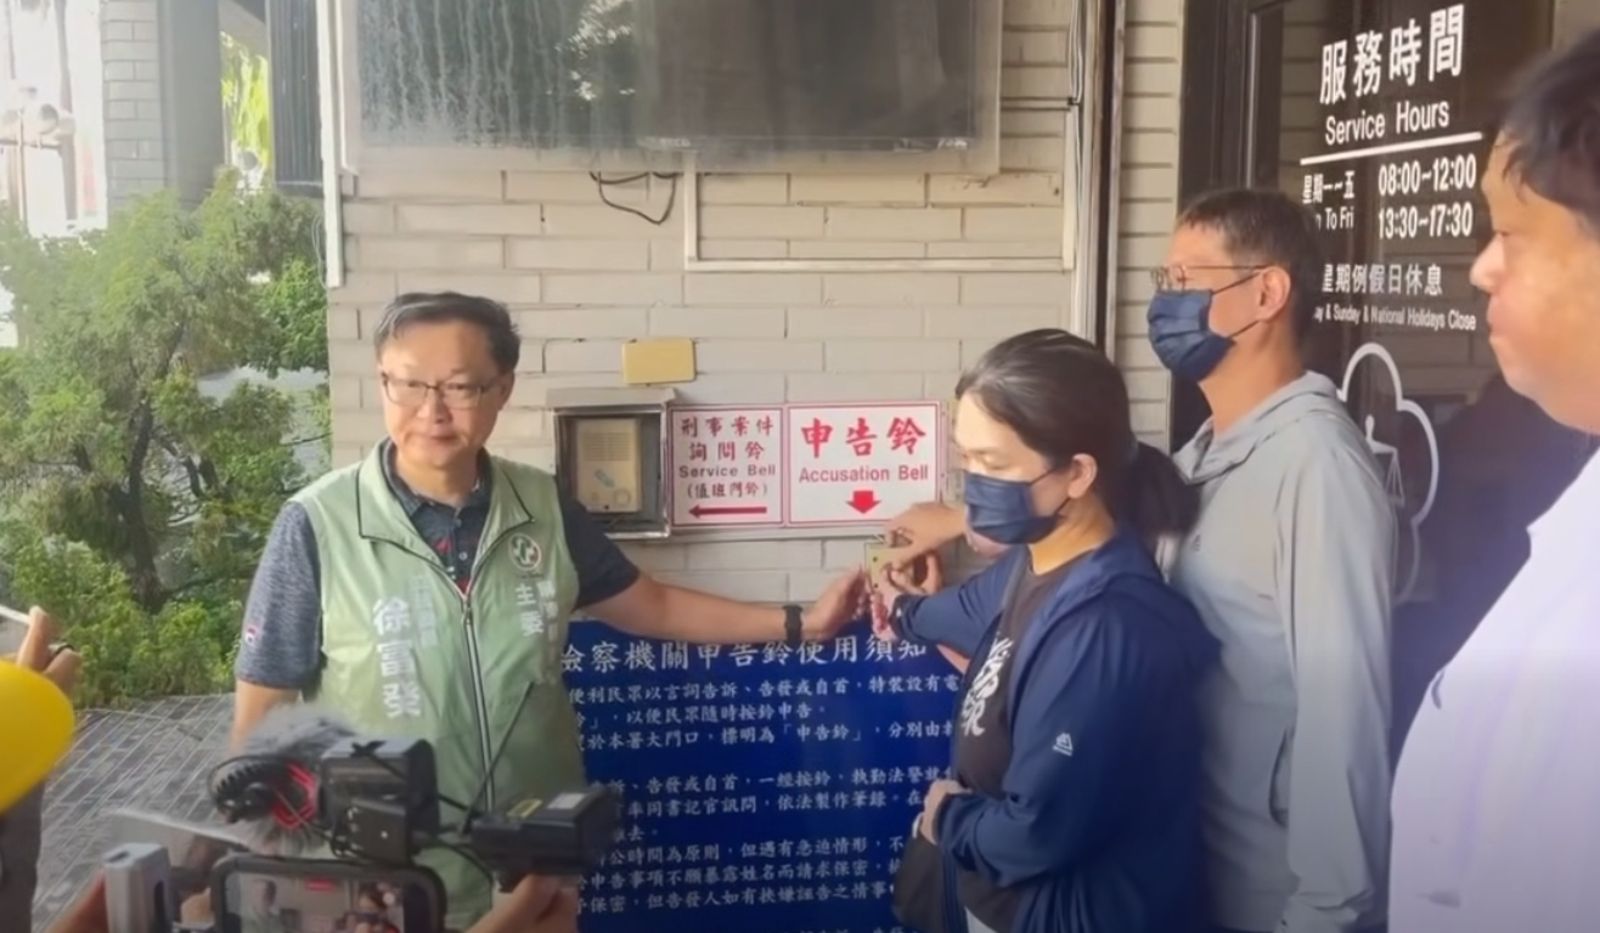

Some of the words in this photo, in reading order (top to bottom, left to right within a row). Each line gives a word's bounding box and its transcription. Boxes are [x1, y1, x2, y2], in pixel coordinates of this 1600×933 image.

[1319, 3, 1464, 105] 服務時間
[1325, 110, 1386, 146] Service
[1396, 100, 1450, 135] Hours
[1325, 207, 1337, 231] To
[1340, 206, 1354, 229] Fri
[1321, 263, 1443, 296] 星期例假日休息
[1334, 304, 1361, 325] Sunday
[1371, 305, 1405, 326] National
[1408, 307, 1445, 331] Holidays
[1448, 309, 1477, 331] Close
[680, 415, 774, 438] 刑事案件
[801, 416, 927, 459] 申告鈴
[689, 441, 765, 462] 詢問鈴
[679, 464, 739, 479] Service
[747, 462, 776, 477] Bell
[800, 465, 890, 484] Accusation
[898, 464, 929, 481] Bell
[515, 582, 544, 637] 主委
